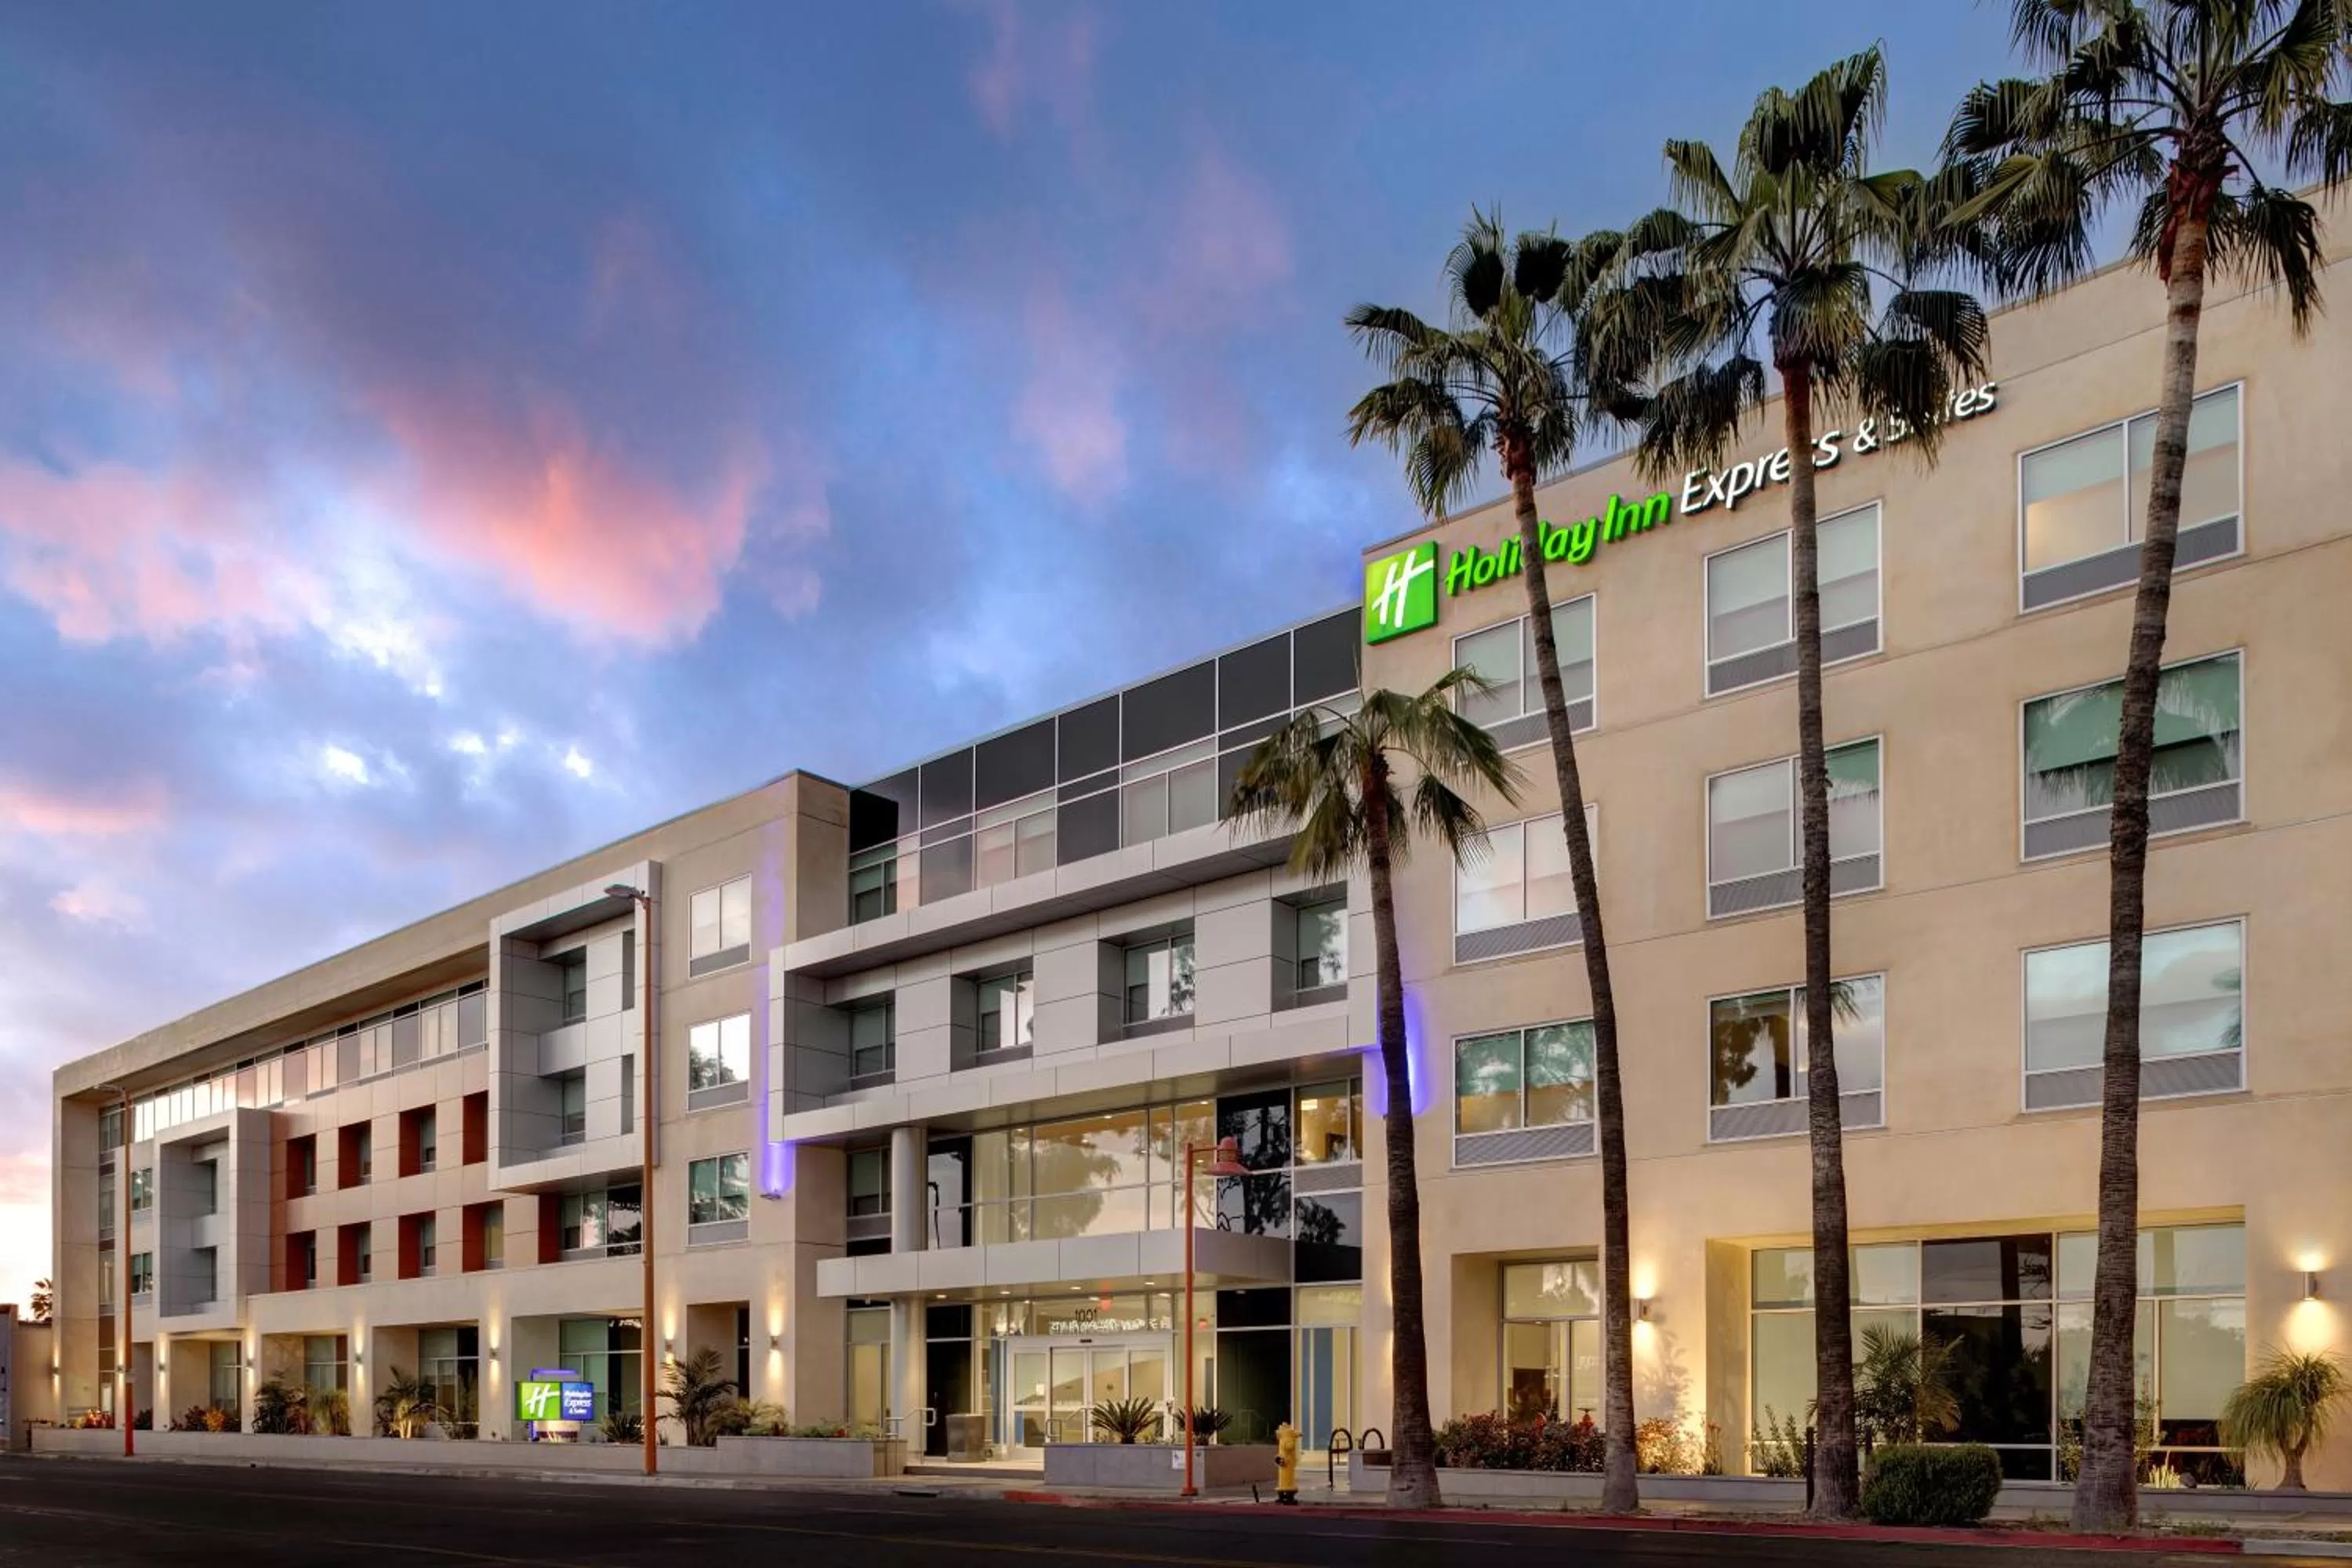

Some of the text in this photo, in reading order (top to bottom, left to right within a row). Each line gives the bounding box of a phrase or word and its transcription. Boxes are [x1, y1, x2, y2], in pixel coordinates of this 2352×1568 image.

[1444, 515, 1599, 596] Holiay
[1602, 492, 1671, 543] Inn
[1680, 430, 1842, 514] Expres
[1853, 416, 1879, 453] &
